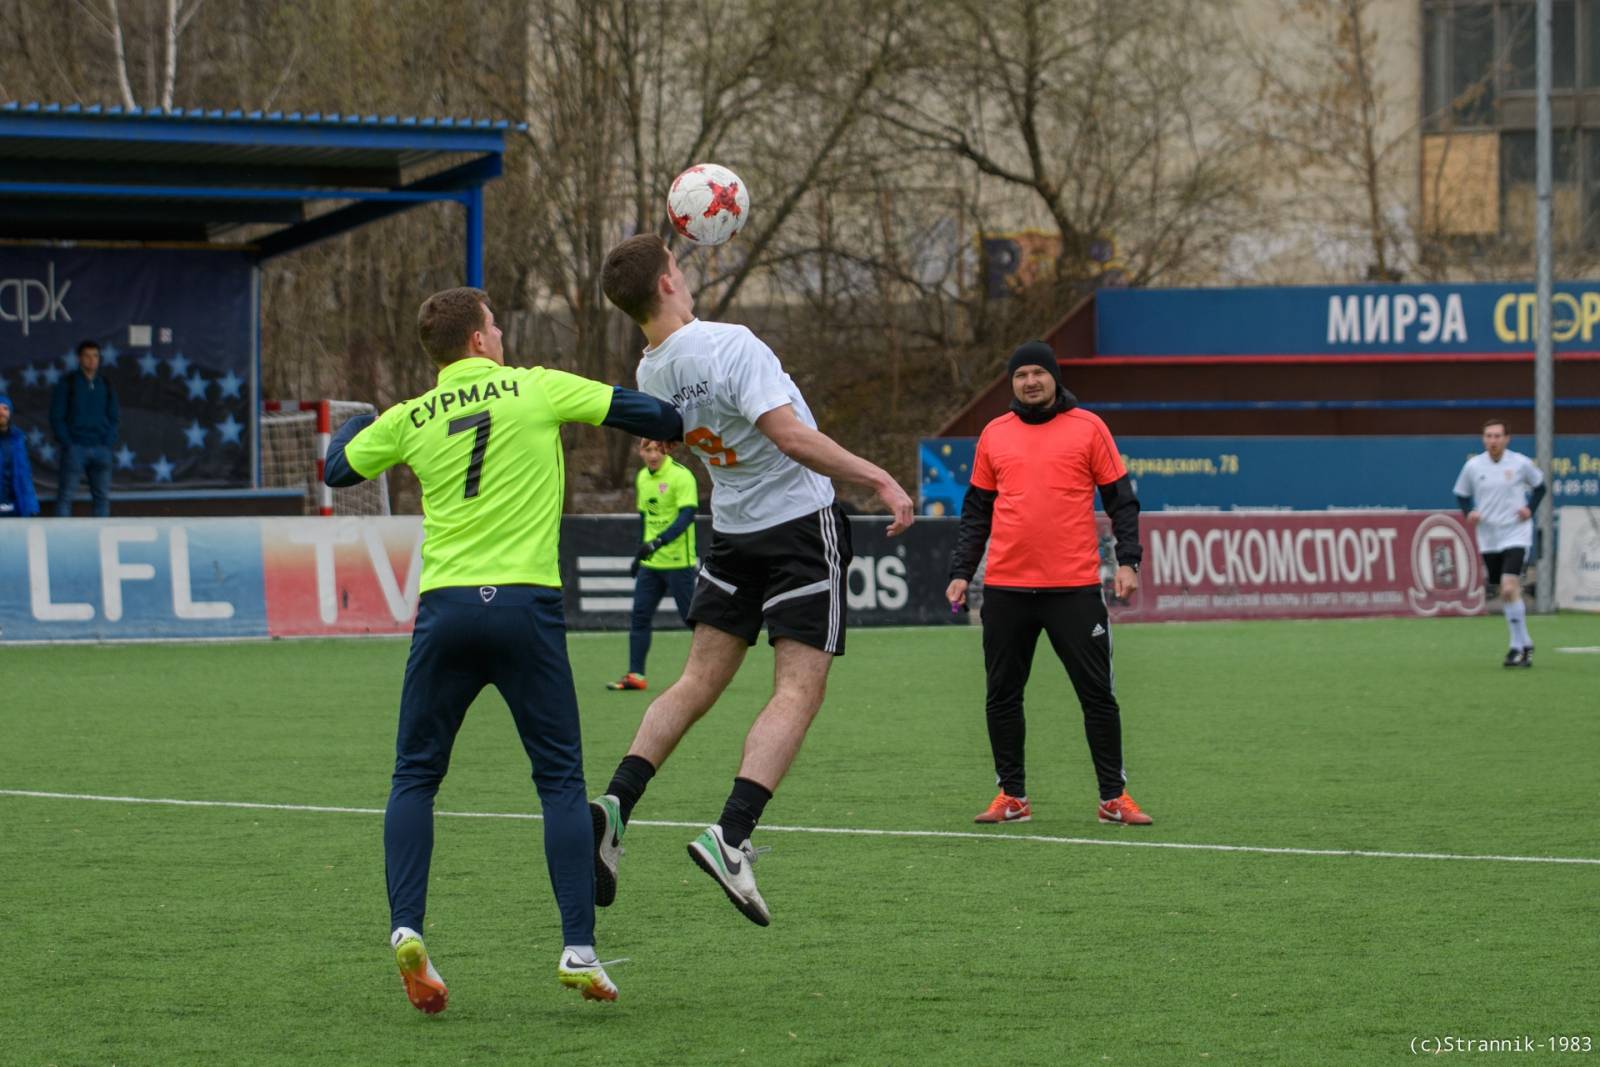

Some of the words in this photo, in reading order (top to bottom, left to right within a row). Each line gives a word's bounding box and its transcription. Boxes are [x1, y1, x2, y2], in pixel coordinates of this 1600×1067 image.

[1327, 293, 1468, 343] МИРЭА
[410, 380, 519, 428] СУРМАЧ
[447, 409, 492, 499] 7
[27, 525, 235, 622] LFL
[290, 522, 421, 625] TV
[1151, 528, 1397, 586] МОСКОМСПОРТ
